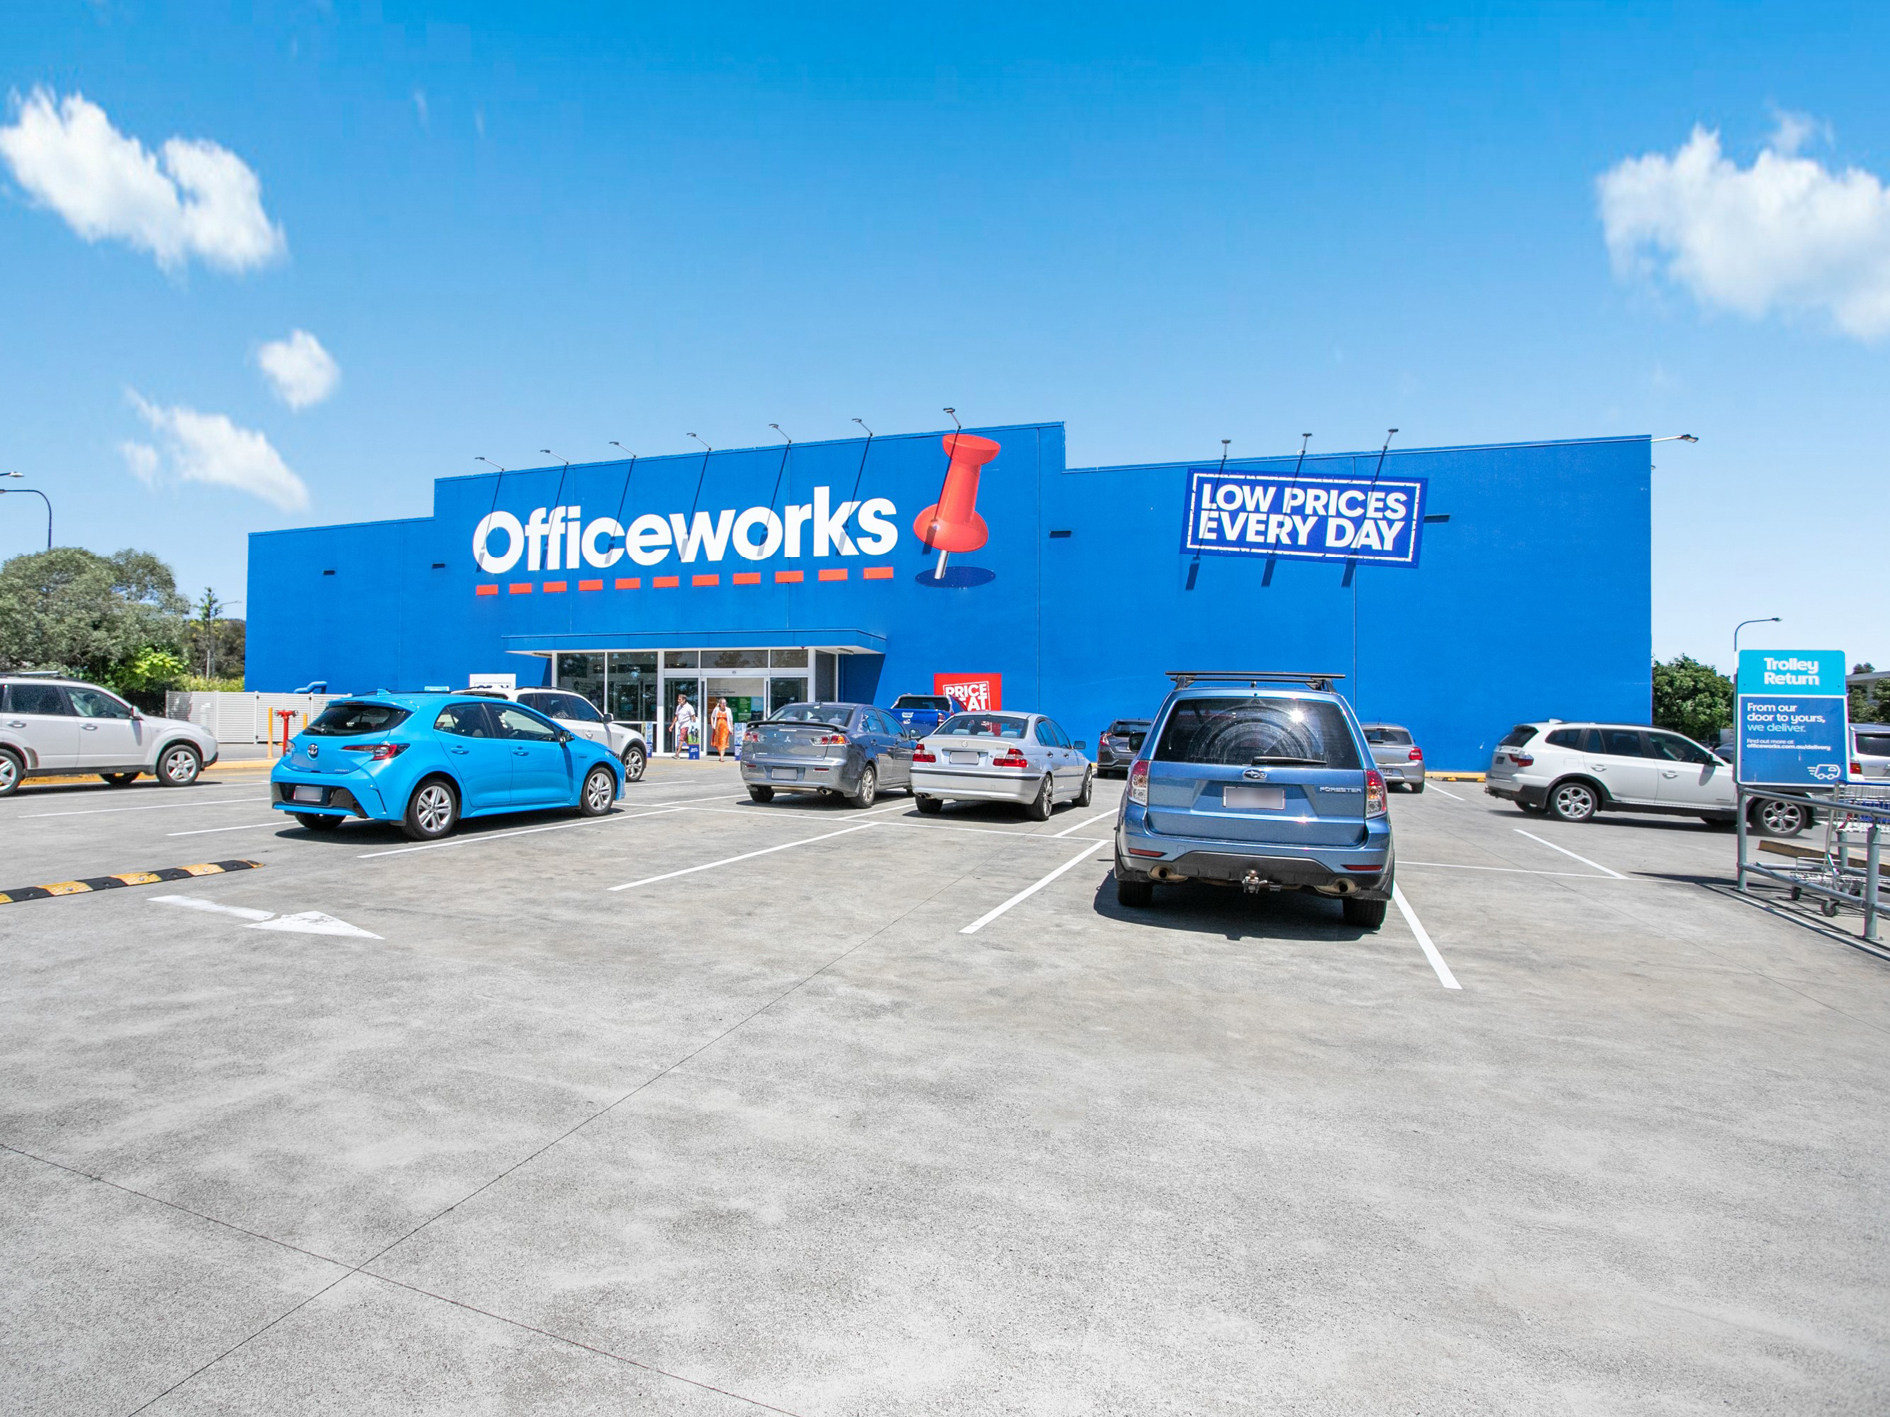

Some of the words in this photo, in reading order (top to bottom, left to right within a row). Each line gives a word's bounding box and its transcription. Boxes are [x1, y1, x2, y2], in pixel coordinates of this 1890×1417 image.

[1201, 483, 1277, 512] LOW
[1282, 487, 1408, 520] PRICES
[473, 486, 898, 574] Officeworks
[1198, 510, 1319, 546] EVERY
[1325, 517, 1405, 551] DAY
[1763, 657, 1819, 674] Trolley
[1763, 671, 1820, 686] Return
[945, 683, 988, 698] PRICE
[1746, 702, 1776, 712] From
[1777, 704, 1798, 712] our
[1746, 712, 1774, 722] door
[1775, 713, 1789, 722] to
[1790, 714, 1826, 724] yours,
[1746, 723, 1765, 732] we
[1766, 723, 1807, 733] deliver.
[1746, 743, 1831, 751] officeworks.com.au/delivery
